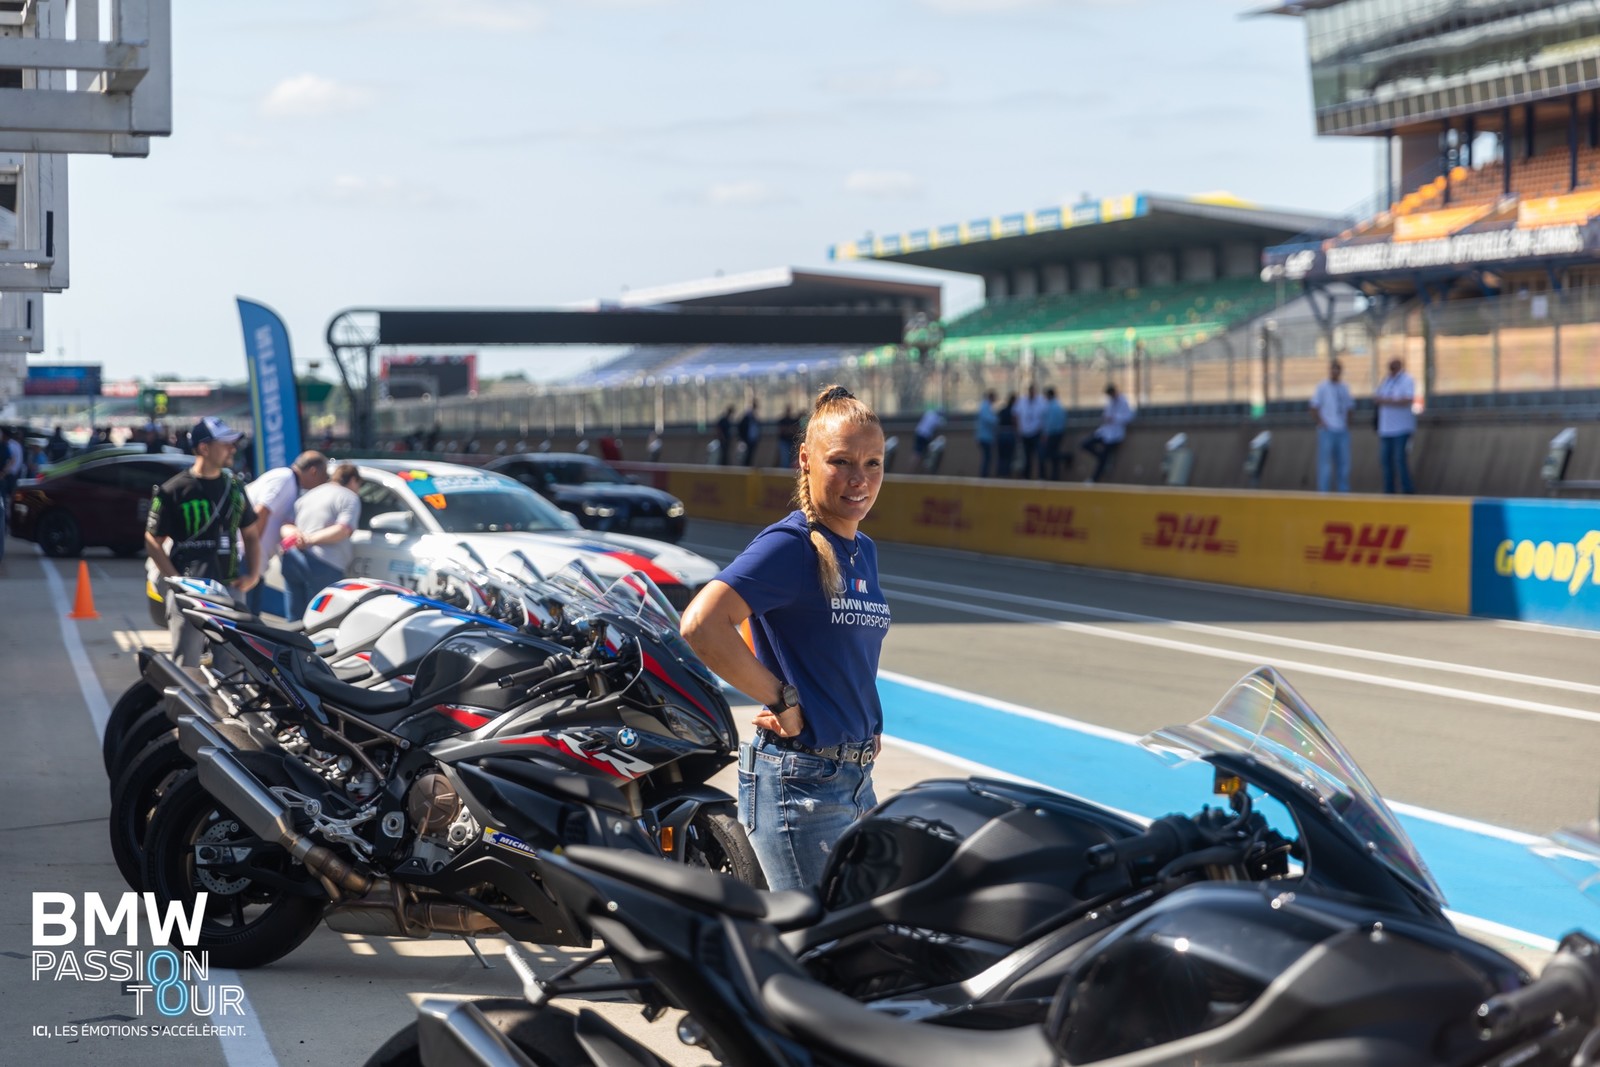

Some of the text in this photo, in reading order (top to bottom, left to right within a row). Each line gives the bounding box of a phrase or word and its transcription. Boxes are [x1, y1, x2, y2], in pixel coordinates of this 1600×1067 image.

[1154, 512, 1224, 552] DHL
[1320, 521, 1412, 569] DHL
[831, 598, 862, 611] BMW
[831, 612, 891, 629] MOTORSPORT
